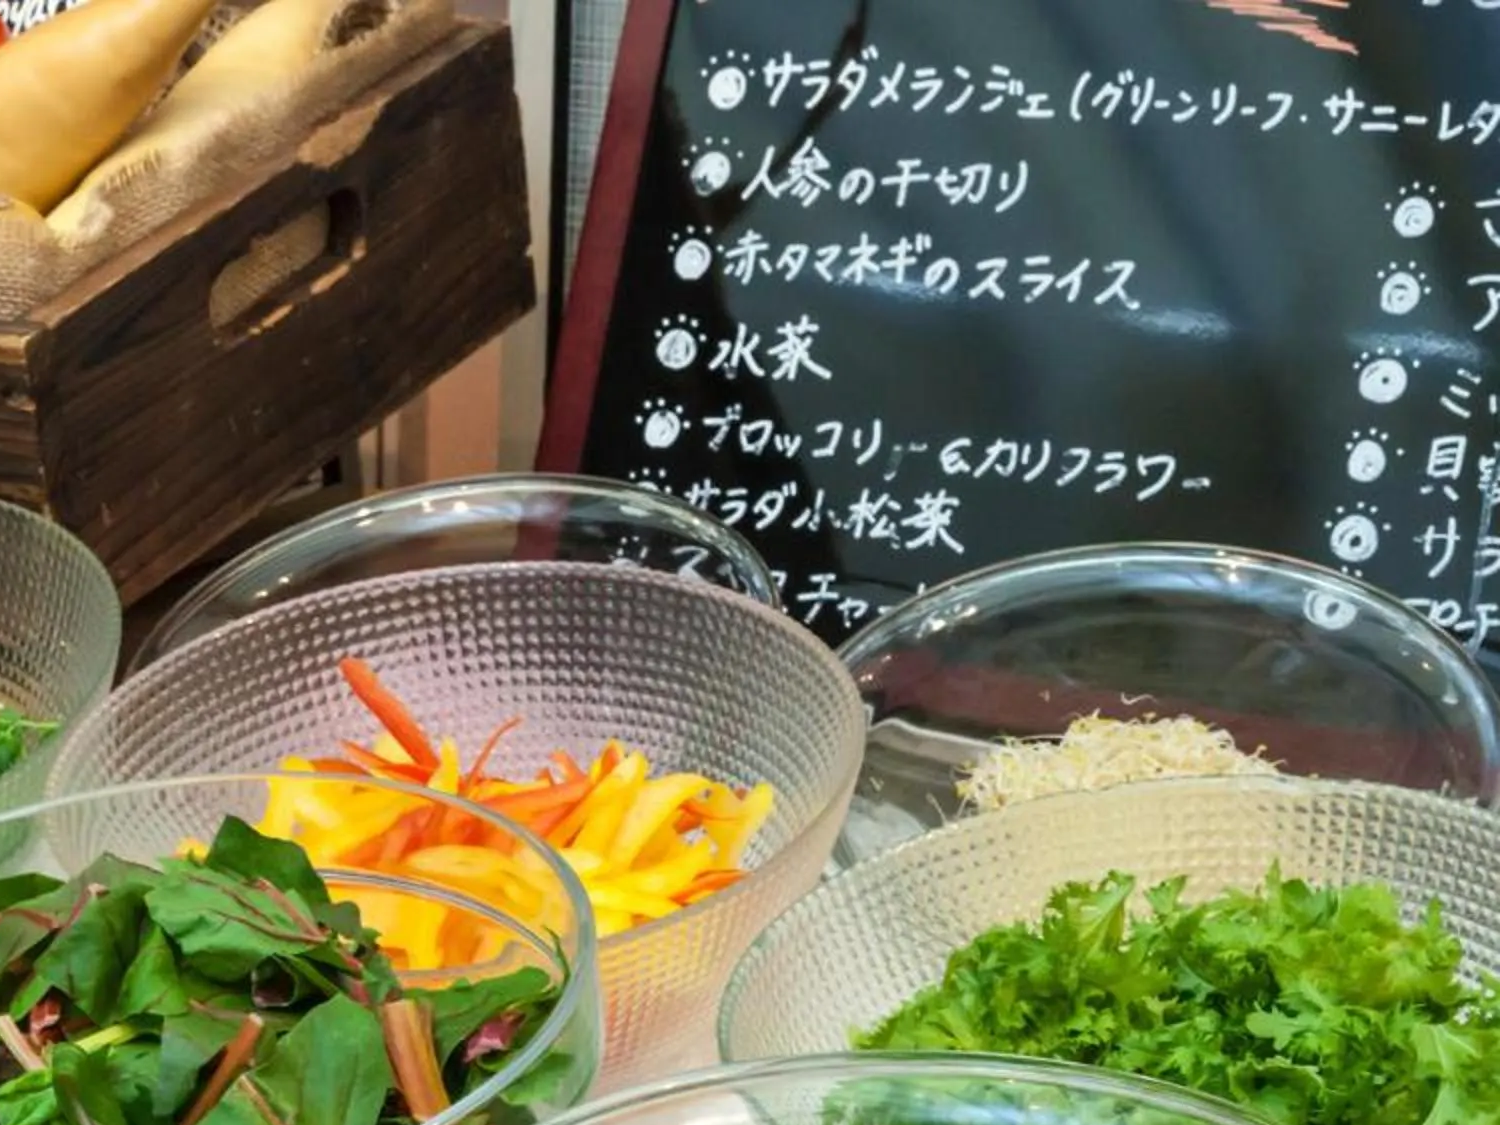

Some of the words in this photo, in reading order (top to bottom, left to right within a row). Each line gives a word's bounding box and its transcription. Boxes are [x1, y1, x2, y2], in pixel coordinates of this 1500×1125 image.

[723, 230, 1140, 309] 赤タマネギのスライス
[708, 314, 832, 380] 水菜
